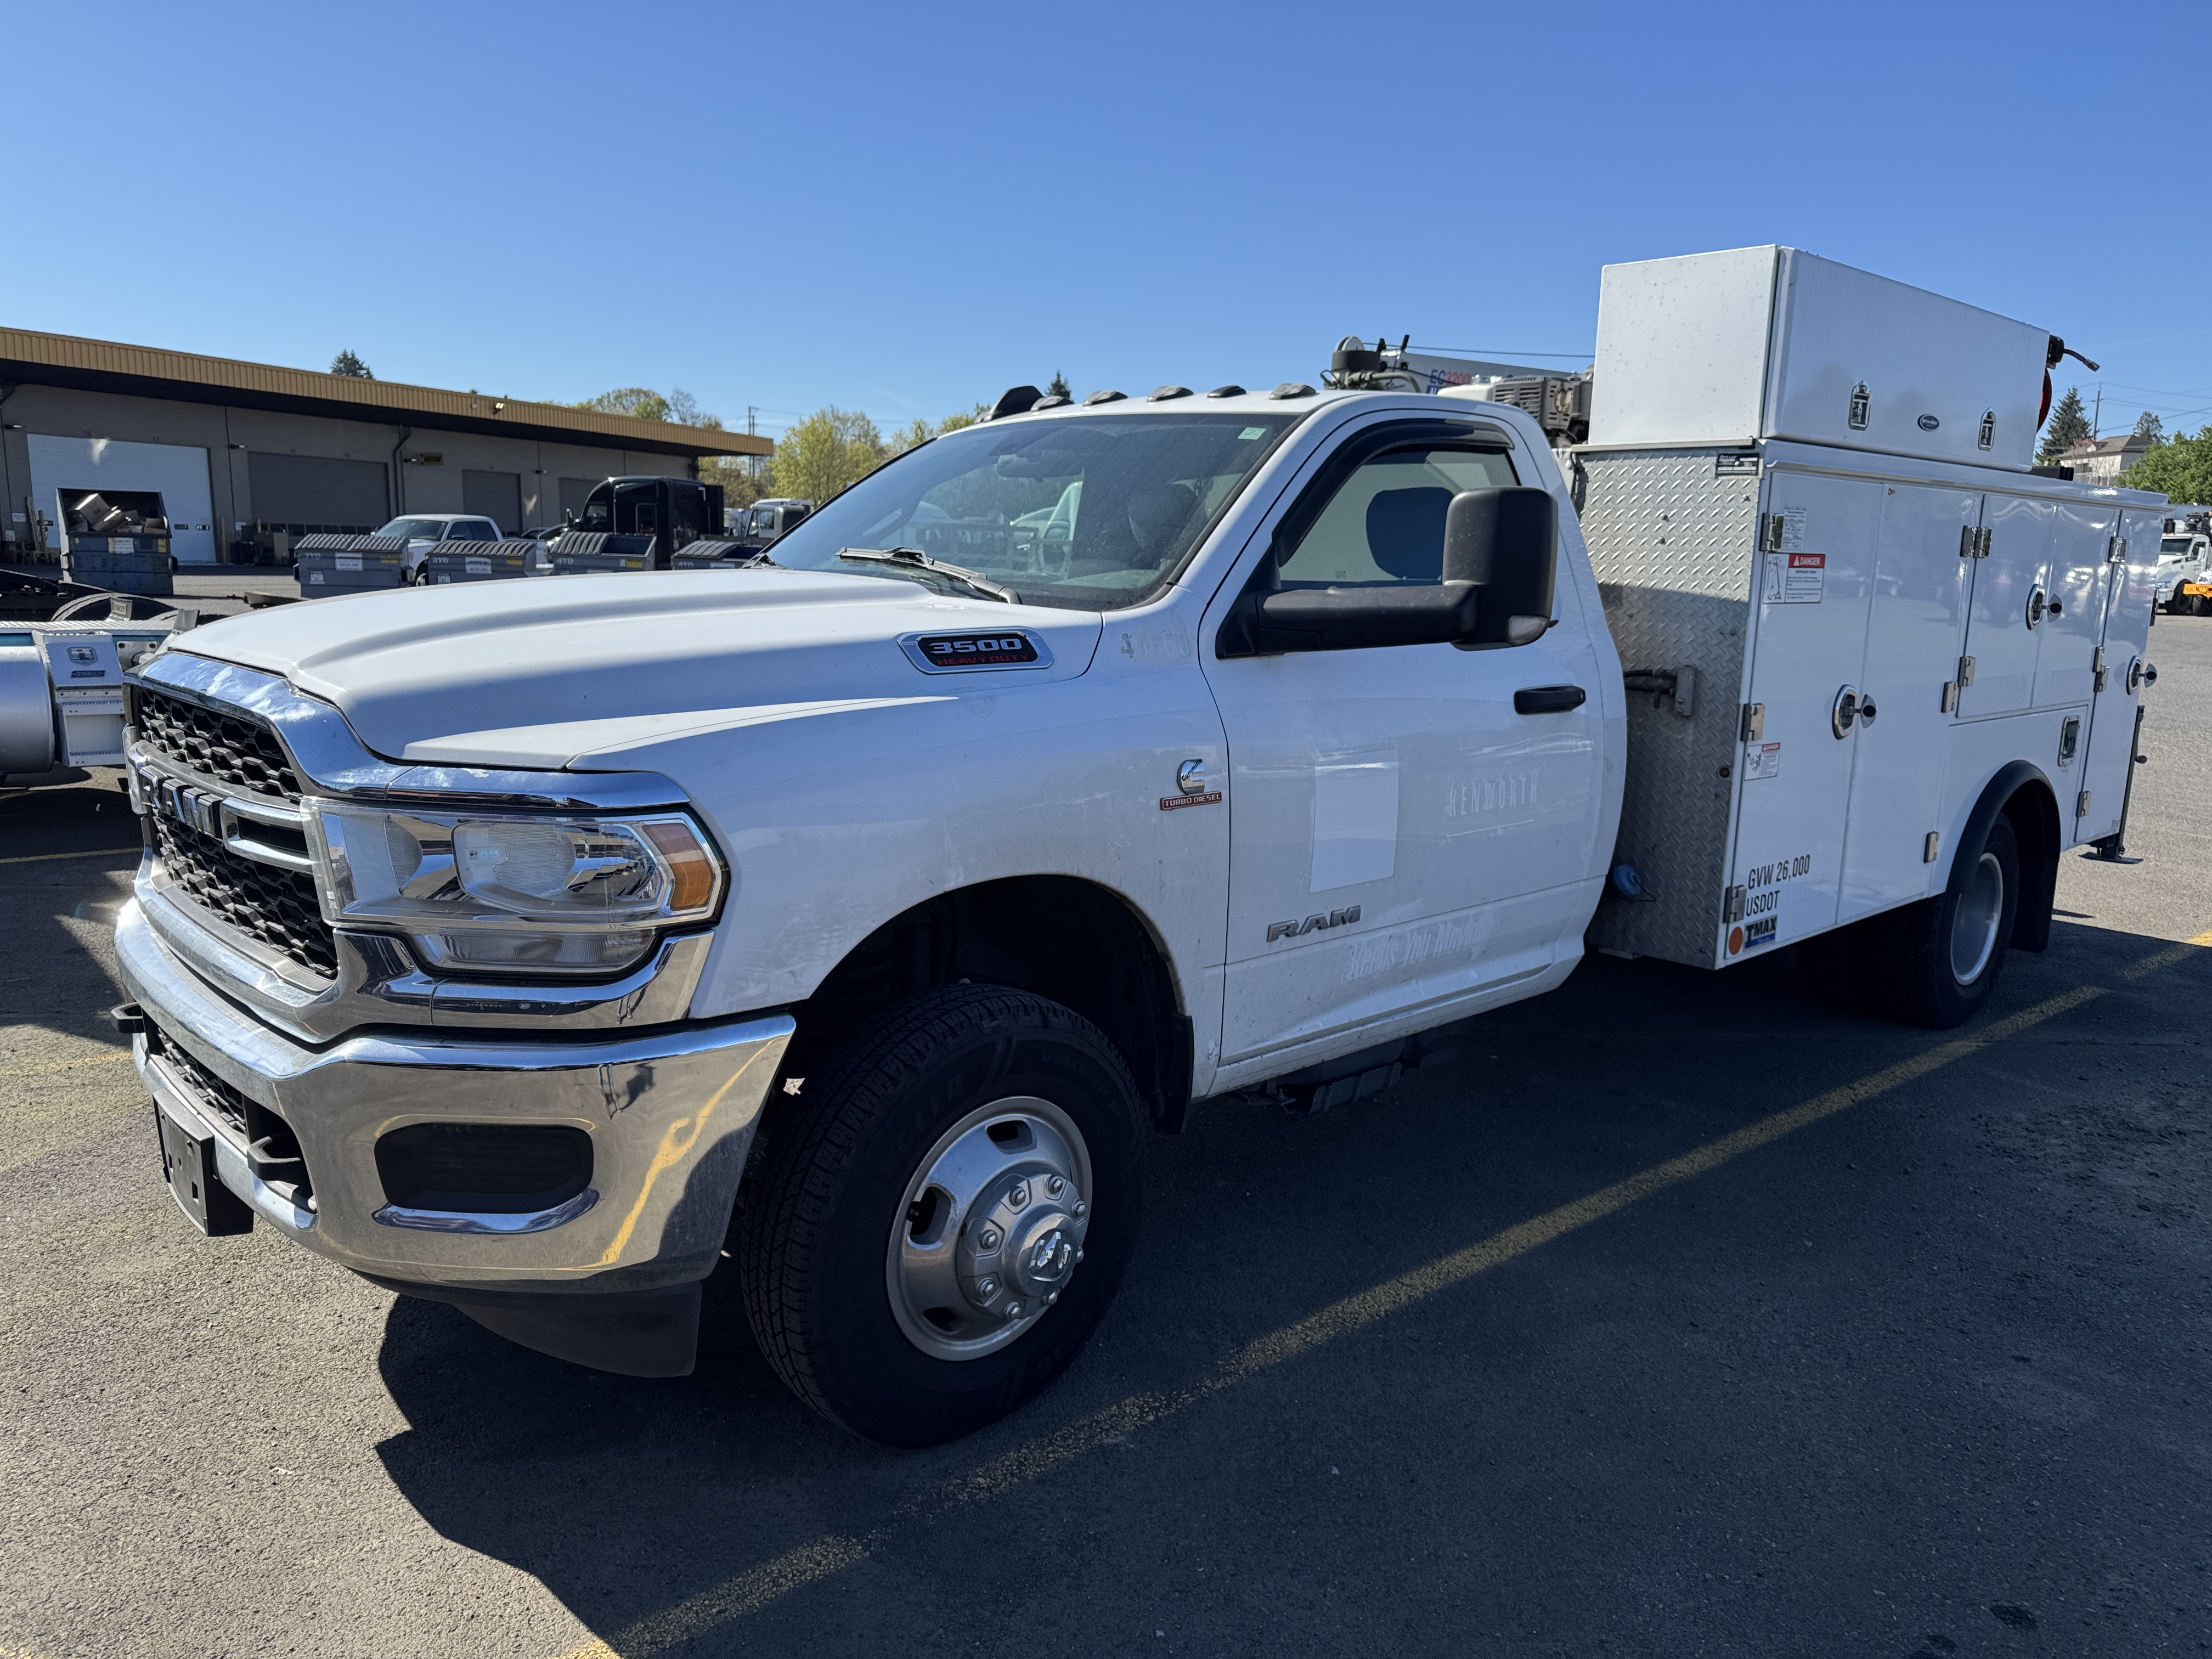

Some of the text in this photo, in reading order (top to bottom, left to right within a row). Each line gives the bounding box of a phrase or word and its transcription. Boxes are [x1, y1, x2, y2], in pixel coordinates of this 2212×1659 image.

[1799, 557, 1821, 566] DANGER
[929, 638, 1022, 654] 3500
[936, 656, 986, 666] HEAVY
[1181, 759, 1203, 781] Cummins
[138, 765, 224, 840] RAM
[1165, 794, 1221, 808] TURBO DIESEL
[1448, 775, 1538, 817] KENWORTH
[1748, 854, 1810, 890] GVW 26,000
[1746, 890, 1780, 917] USDOT
[1267, 905, 1361, 942] RAM
[1745, 916, 1778, 949] TMAX
